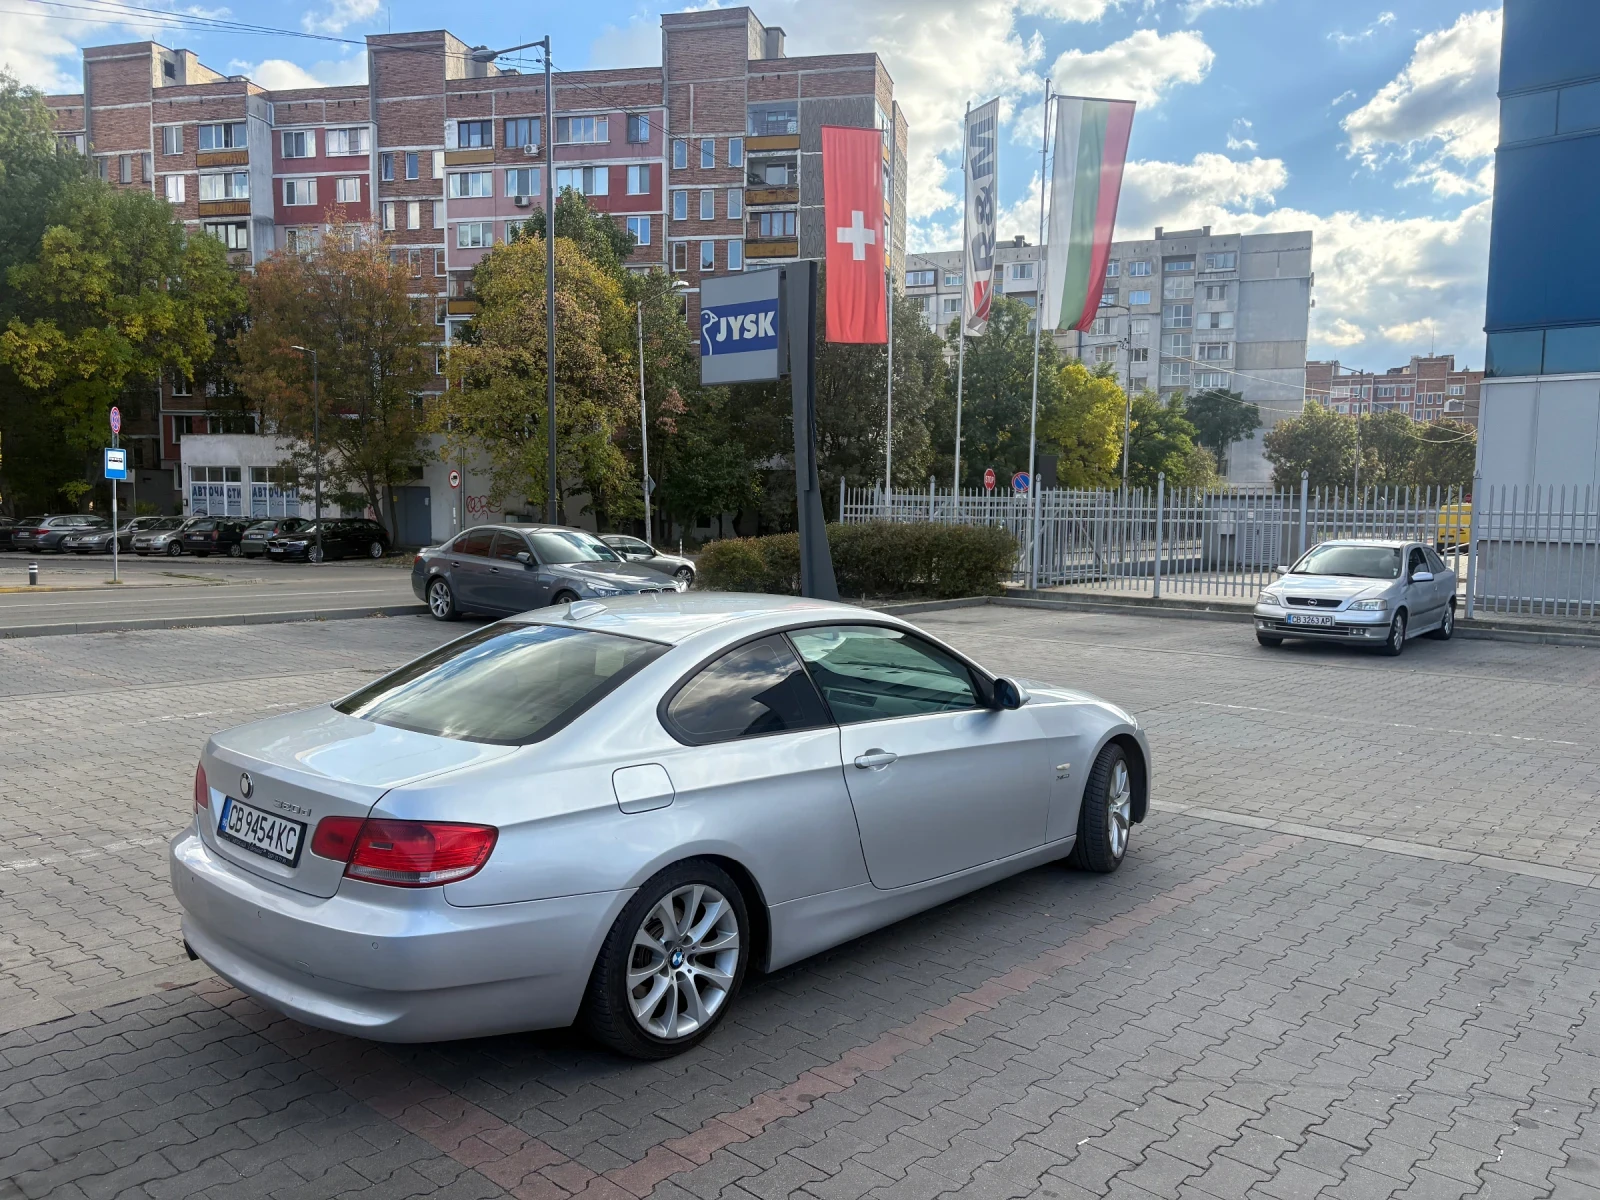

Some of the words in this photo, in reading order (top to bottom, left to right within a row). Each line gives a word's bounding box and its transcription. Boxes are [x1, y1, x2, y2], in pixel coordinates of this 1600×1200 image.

[715, 310, 776, 342] JYSK
[985, 475, 994, 484] STOP
[1303, 616, 1320, 624] 3263
[228, 804, 244, 833] CB
[244, 811, 276, 847] 9454
[275, 822, 297, 855] KC
